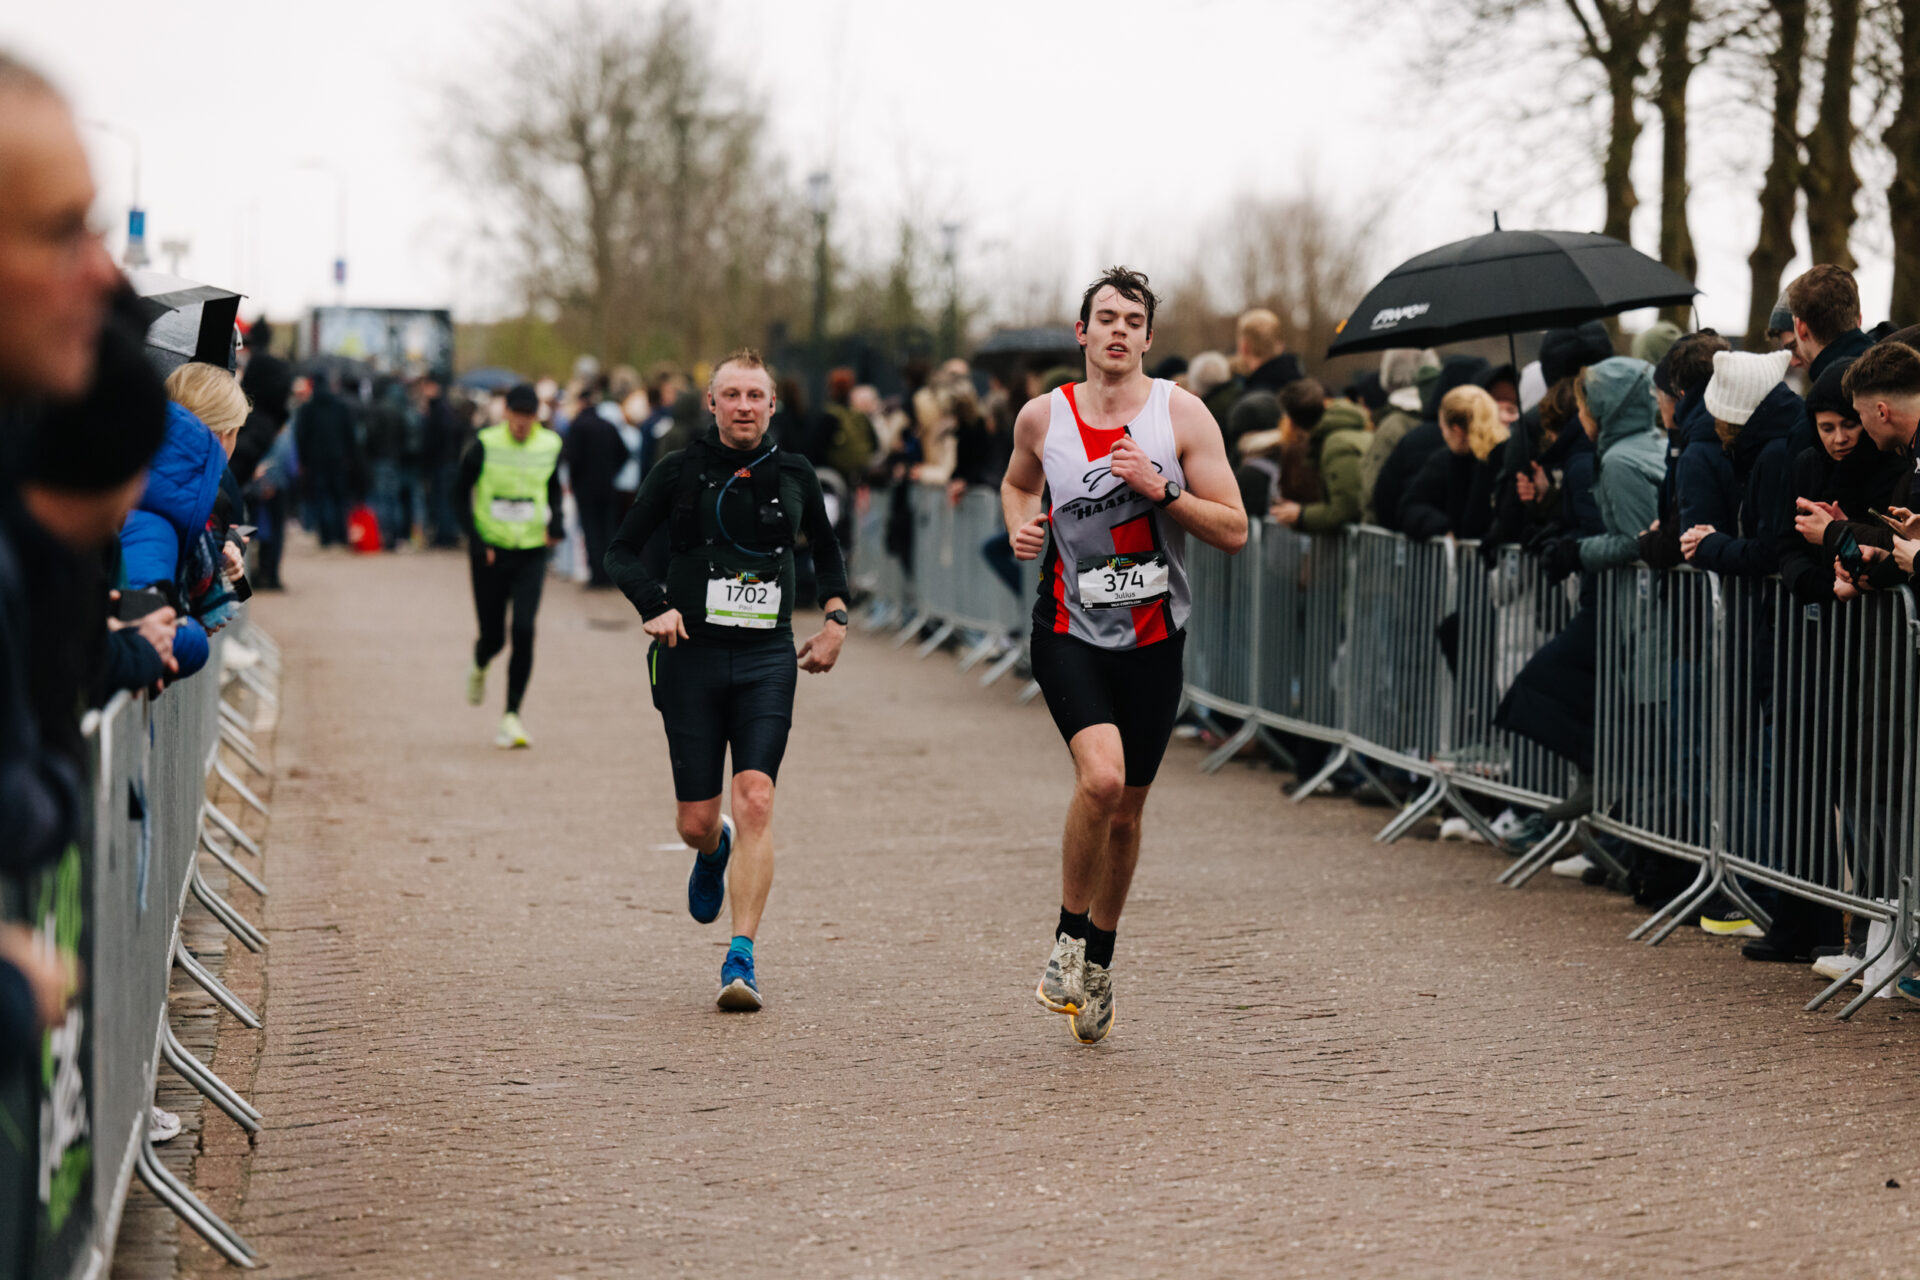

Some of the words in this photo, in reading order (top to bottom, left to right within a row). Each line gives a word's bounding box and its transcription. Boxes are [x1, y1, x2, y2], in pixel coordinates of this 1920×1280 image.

[1103, 570, 1144, 592] 374
[726, 584, 767, 604] 1702
[1114, 592, 1136, 600] Julius
